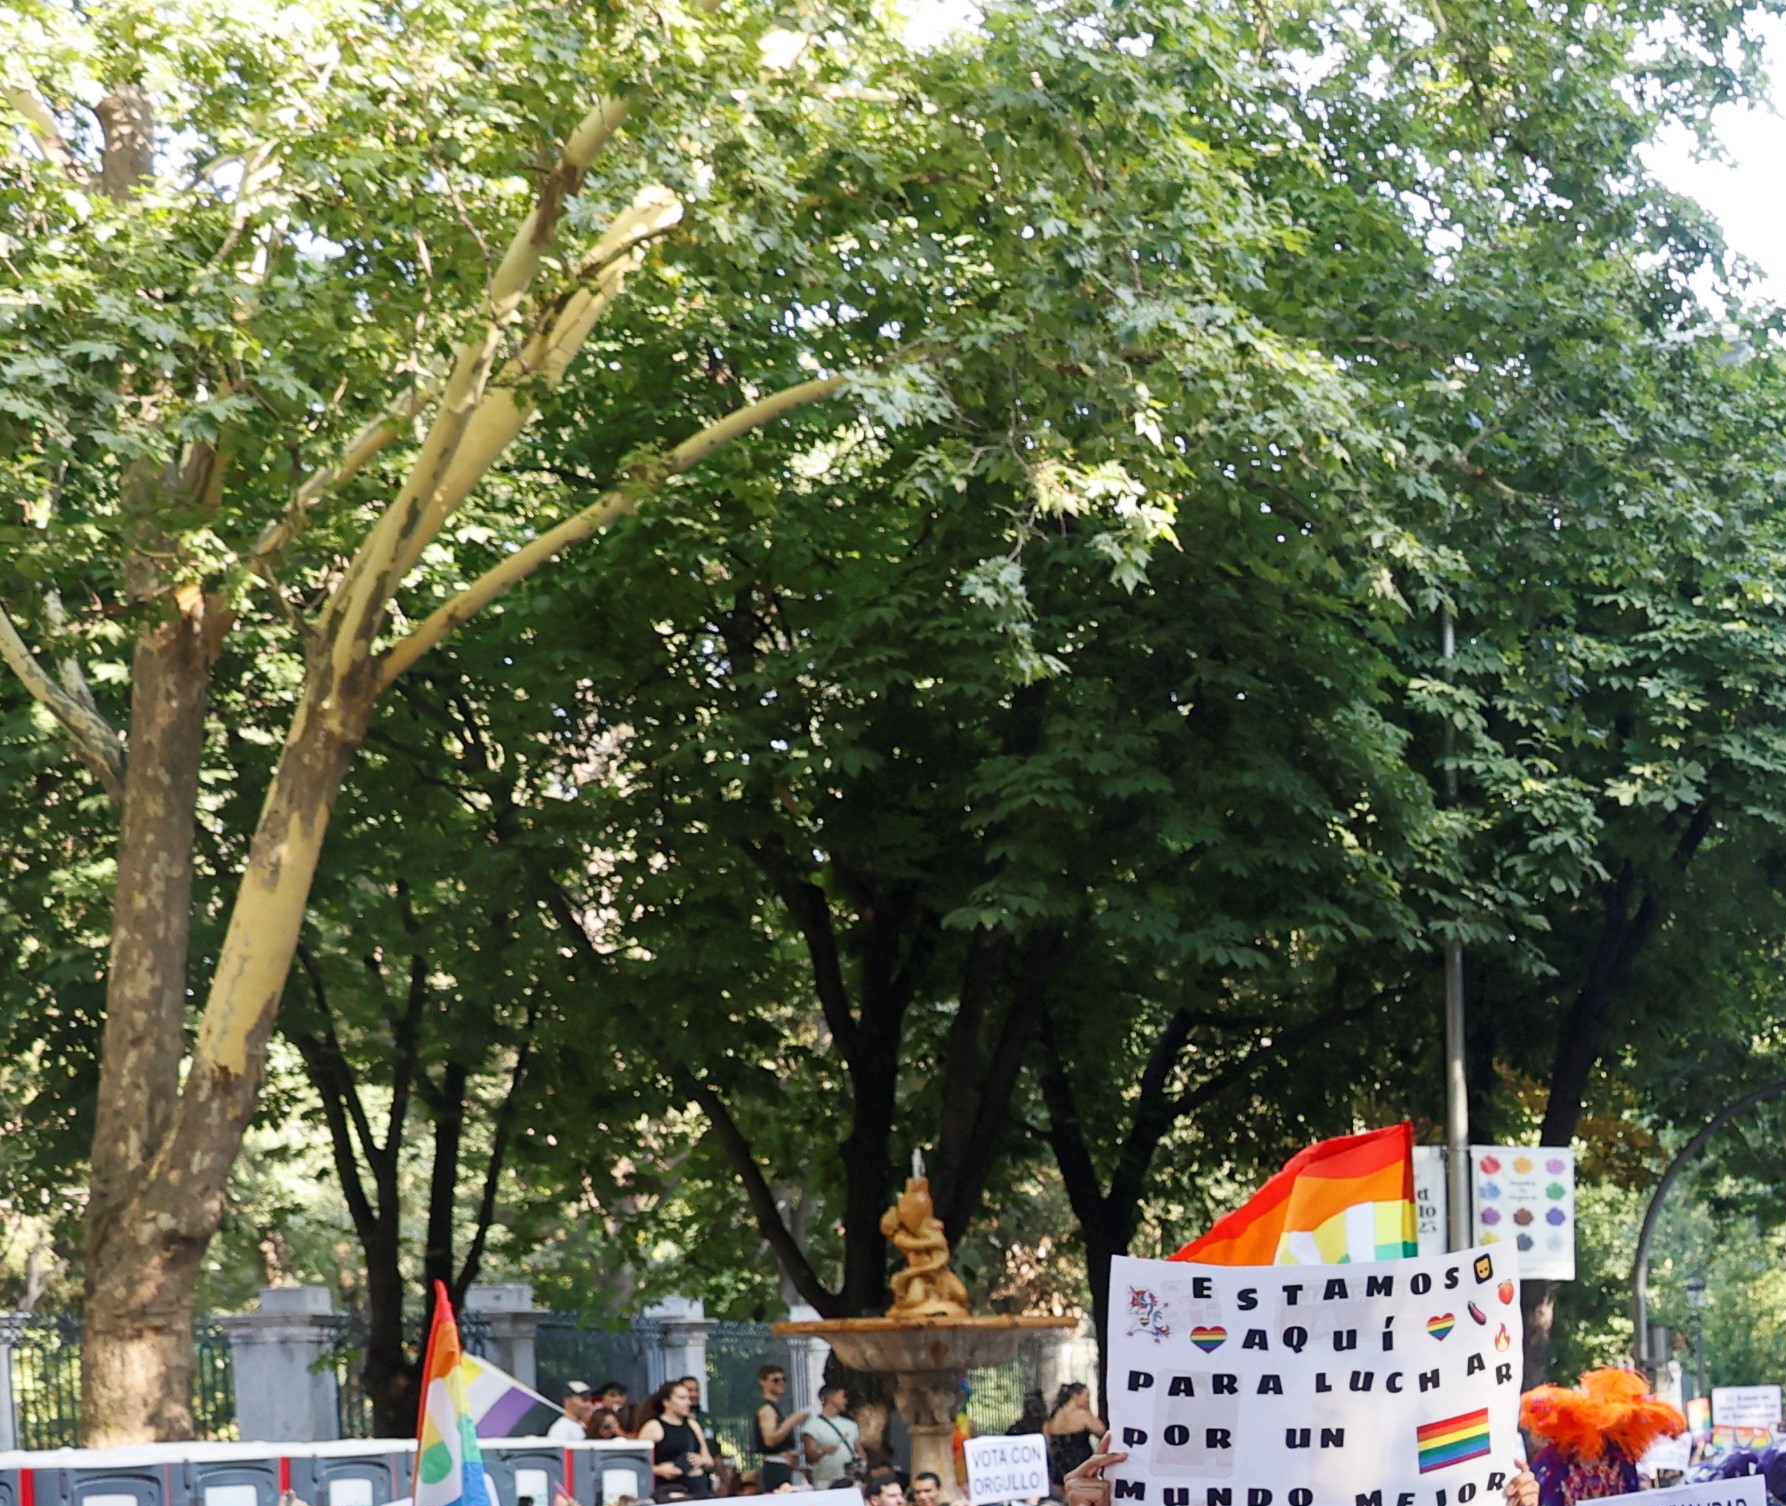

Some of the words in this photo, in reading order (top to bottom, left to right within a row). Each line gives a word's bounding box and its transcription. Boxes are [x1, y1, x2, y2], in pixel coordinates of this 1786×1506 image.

[1192, 1266, 1460, 1311] ESTAMOS
[1241, 1316, 1395, 1354] AQUÍ
[1127, 1370, 1284, 1398] PARA
[1315, 1352, 1513, 1394] LUCHAR
[1122, 1423, 1233, 1449] POR
[1285, 1427, 1345, 1449] UN
[971, 1449, 1008, 1469] VOTA
[1012, 1445, 1041, 1464] CON
